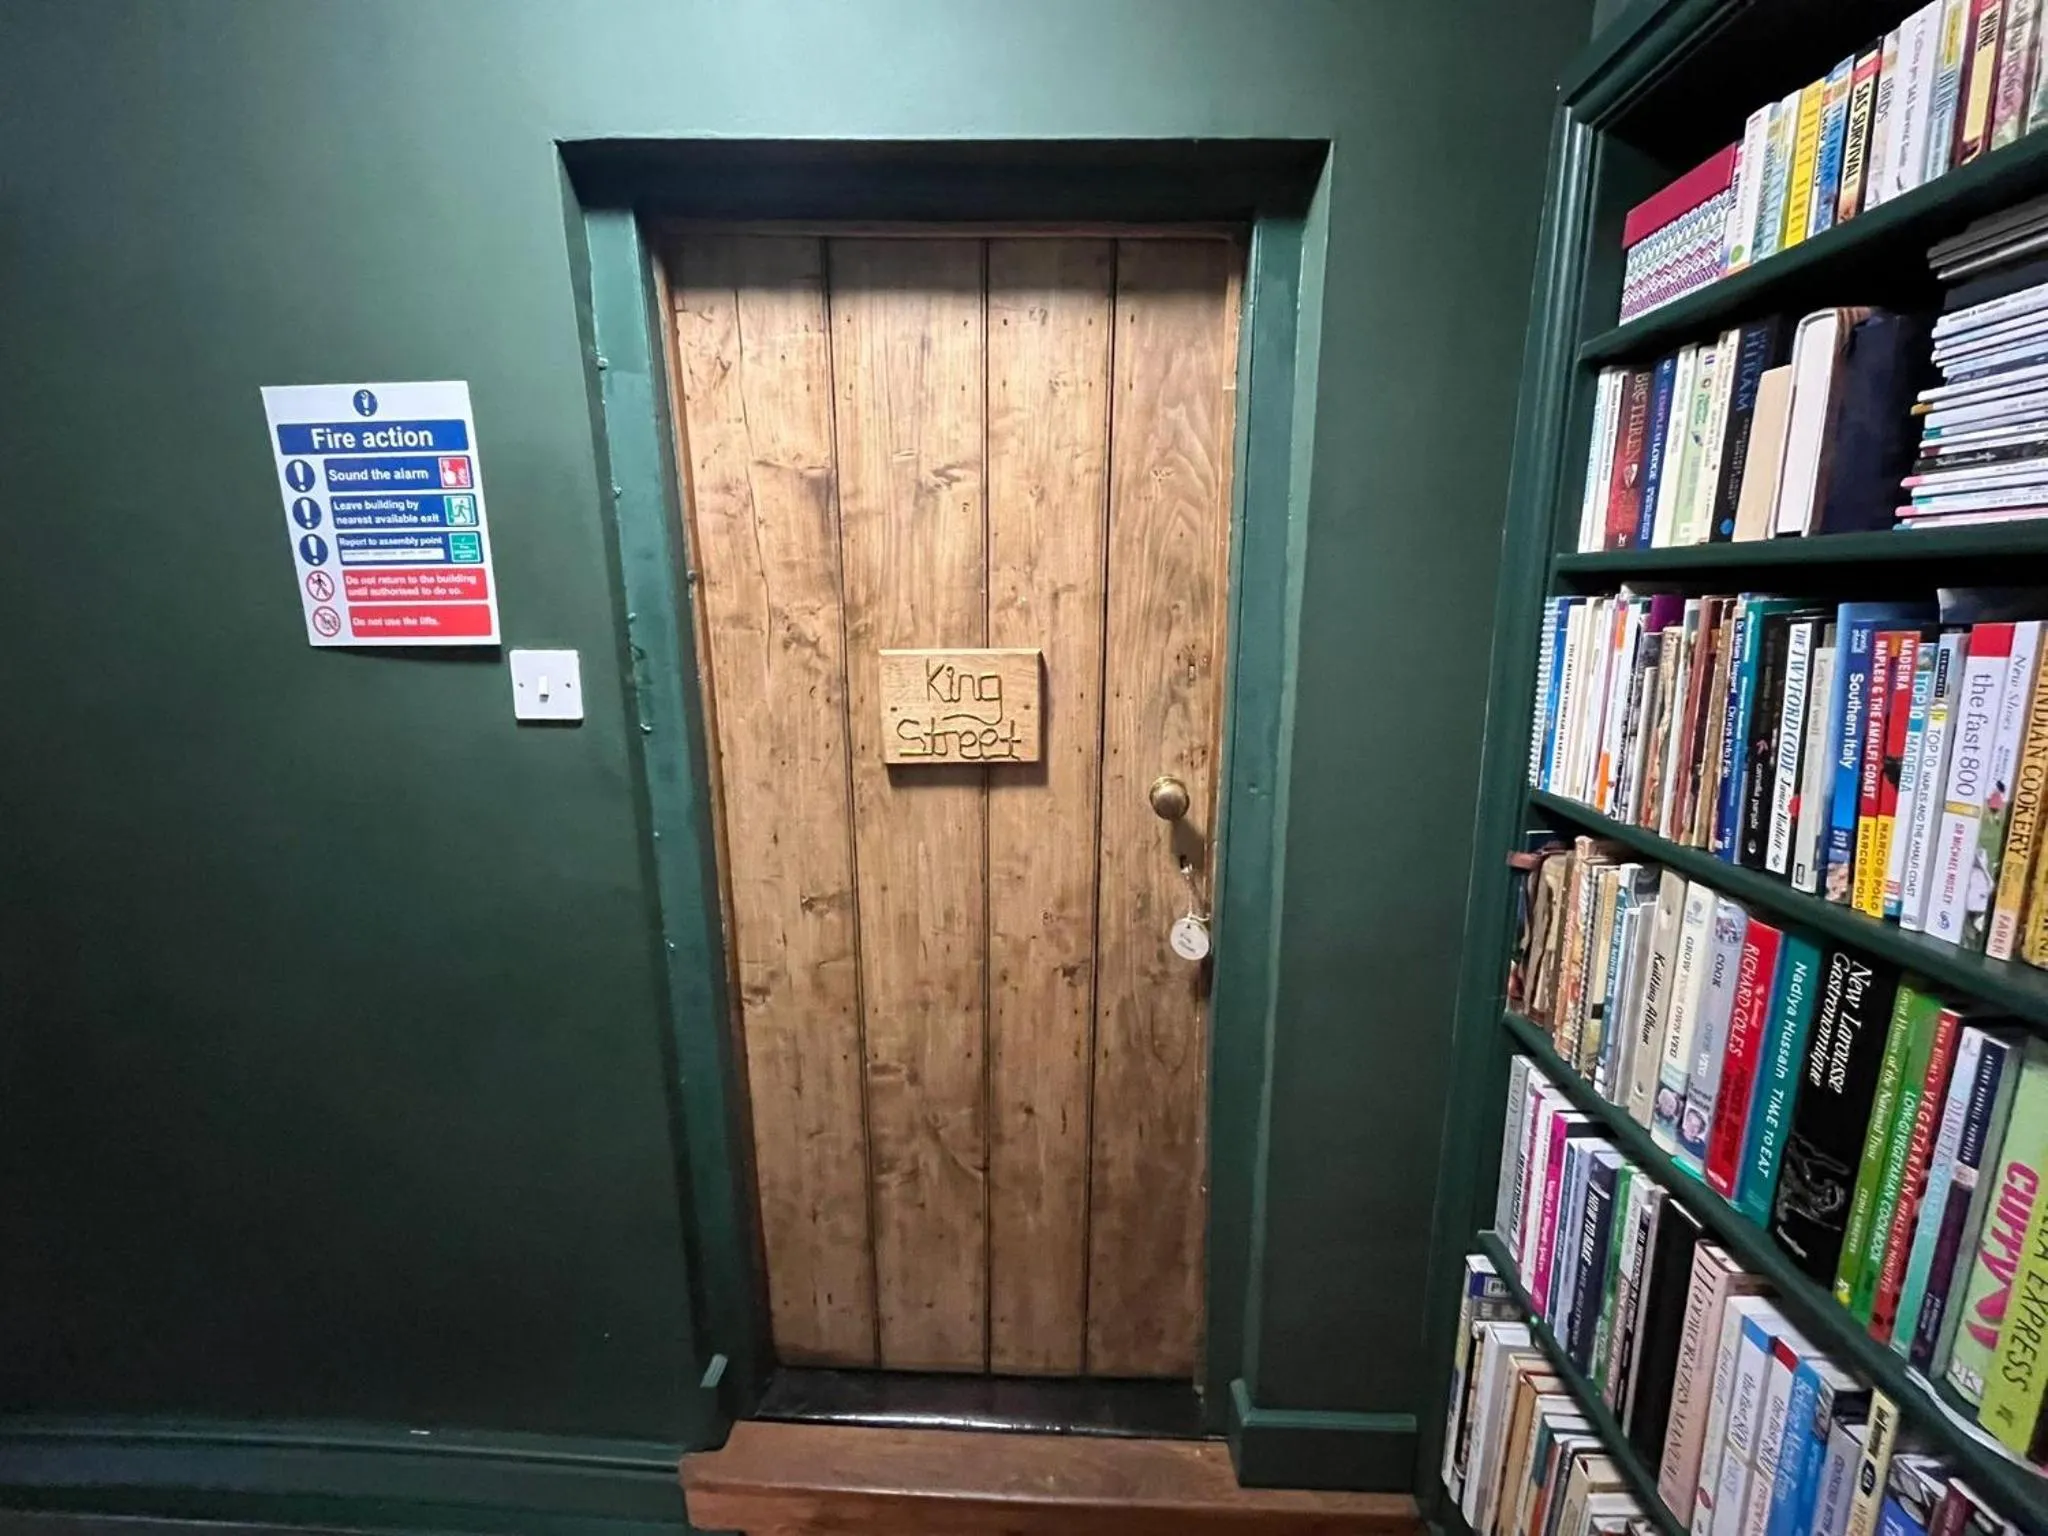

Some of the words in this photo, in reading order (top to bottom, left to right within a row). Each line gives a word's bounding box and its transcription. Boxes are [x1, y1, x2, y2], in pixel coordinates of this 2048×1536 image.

[1977, 10, 1998, 52] WINE
[1854, 82, 1870, 116] SAS
[1845, 112, 1866, 182] SURVIVAL
[311, 428, 356, 450] Fire
[363, 428, 434, 448] action
[328, 468, 369, 481] Sound
[371, 468, 391, 481] the
[394, 467, 429, 480] alarm
[334, 501, 363, 511] Leave
[365, 499, 406, 511] building
[407, 500, 420, 512] by
[336, 515, 373, 525] nearest
[375, 513, 418, 524] available
[420, 513, 440, 523] exit
[339, 537, 368, 547] Report
[368, 538, 379, 546] to
[379, 536, 419, 547] assembly
[420, 536, 443, 546] point
[346, 575, 360, 585] Do
[362, 575, 376, 585] not
[378, 575, 406, 585] return
[408, 574, 418, 584] to
[420, 573, 435, 584] the
[437, 573, 477, 585] building
[353, 617, 366, 627] Do
[368, 617, 383, 627] not
[403, 617, 418, 627] the
[1795, 628, 1807, 644] THE
[1733, 632, 1743, 658] Miriam
[1872, 640, 1888, 685] NAPLES
[1896, 639, 1915, 690] MADEIRA
[1935, 650, 1949, 697] EYEWITNESS
[2009, 655, 2028, 689] New
[926, 658, 1004, 726] King
[1782, 646, 1808, 731] TWYFORD
[1843, 672, 1865, 737] Southern
[1913, 676, 1928, 704] TOP
[1970, 672, 1994, 709] the
[1869, 698, 1883, 719] THE
[1910, 704, 1924, 720] 10
[896, 716, 1023, 762] Street
[1866, 721, 1881, 762] AMALFI
[1928, 730, 1942, 754] TOP
[1963, 712, 1989, 751] fast
[1778, 731, 1799, 776] CODE
[1838, 738, 1858, 770] Italy
[1900, 732, 1919, 793] MADEIRA
[1922, 755, 1937, 768] 10
[1777, 776, 1792, 812] Janice
[1862, 764, 1877, 800] COAST
[1956, 755, 1982, 797] 800
[2010, 765, 2043, 859] COOKERY
[1770, 813, 1789, 851] Hallett
[1858, 823, 1871, 866] MARCO
[1876, 822, 1889, 866] MARCO
[1948, 837, 1964, 871] MICHAEL
[1854, 878, 1867, 909] POLO
[1870, 879, 1882, 910] POLO
[1907, 870, 1917, 897] COAST
[1943, 872, 1958, 907] MOSLEY
[1681, 935, 1694, 973] GROW
[1711, 952, 1726, 989] COOK
[1645, 951, 1667, 1008] Knitting
[1737, 943, 1760, 1008] RICHARD
[1786, 960, 1809, 1018] Nadiya
[1850, 960, 1874, 1010] New
[1640, 1004, 1659, 1047] Album
[1674, 1005, 1684, 1032] OWN
[1729, 1008, 1748, 1058] COLES
[1808, 951, 1850, 1088] Gastronomique
[1669, 1032, 1682, 1060] VEG
[1774, 1019, 1798, 1081] Hussain
[1827, 1010, 1863, 1095] Larousse
[1697, 1051, 1712, 1079] VEG
[1882, 1067, 1897, 1086] the
[1765, 1087, 1785, 1129] TIME
[1873, 1089, 1893, 1137] National
[1866, 1134, 1882, 1160] Trust
[1902, 1090, 1937, 1198] VEGETARIAN
[1942, 1097, 1965, 1161] DIABETES
[1759, 1145, 1775, 1180] EAT
[1587, 1189, 1600, 1217] HOW
[1893, 1199, 1909, 1230] MEALS
[1584, 1217, 1596, 1236] TO
[1869, 1199, 1893, 1265] COOKBOOK
[1580, 1235, 1595, 1267] BAKE
[1880, 1248, 1898, 1293] MINUTES
[2002, 1269, 2048, 1393] EXPRESS
[1740, 1373, 1755, 1396] the
[1736, 1395, 1753, 1421] fast
[1773, 1394, 1786, 1418] the
[1728, 1415, 1749, 1452] 800
[1759, 1438, 1781, 1478] 800
